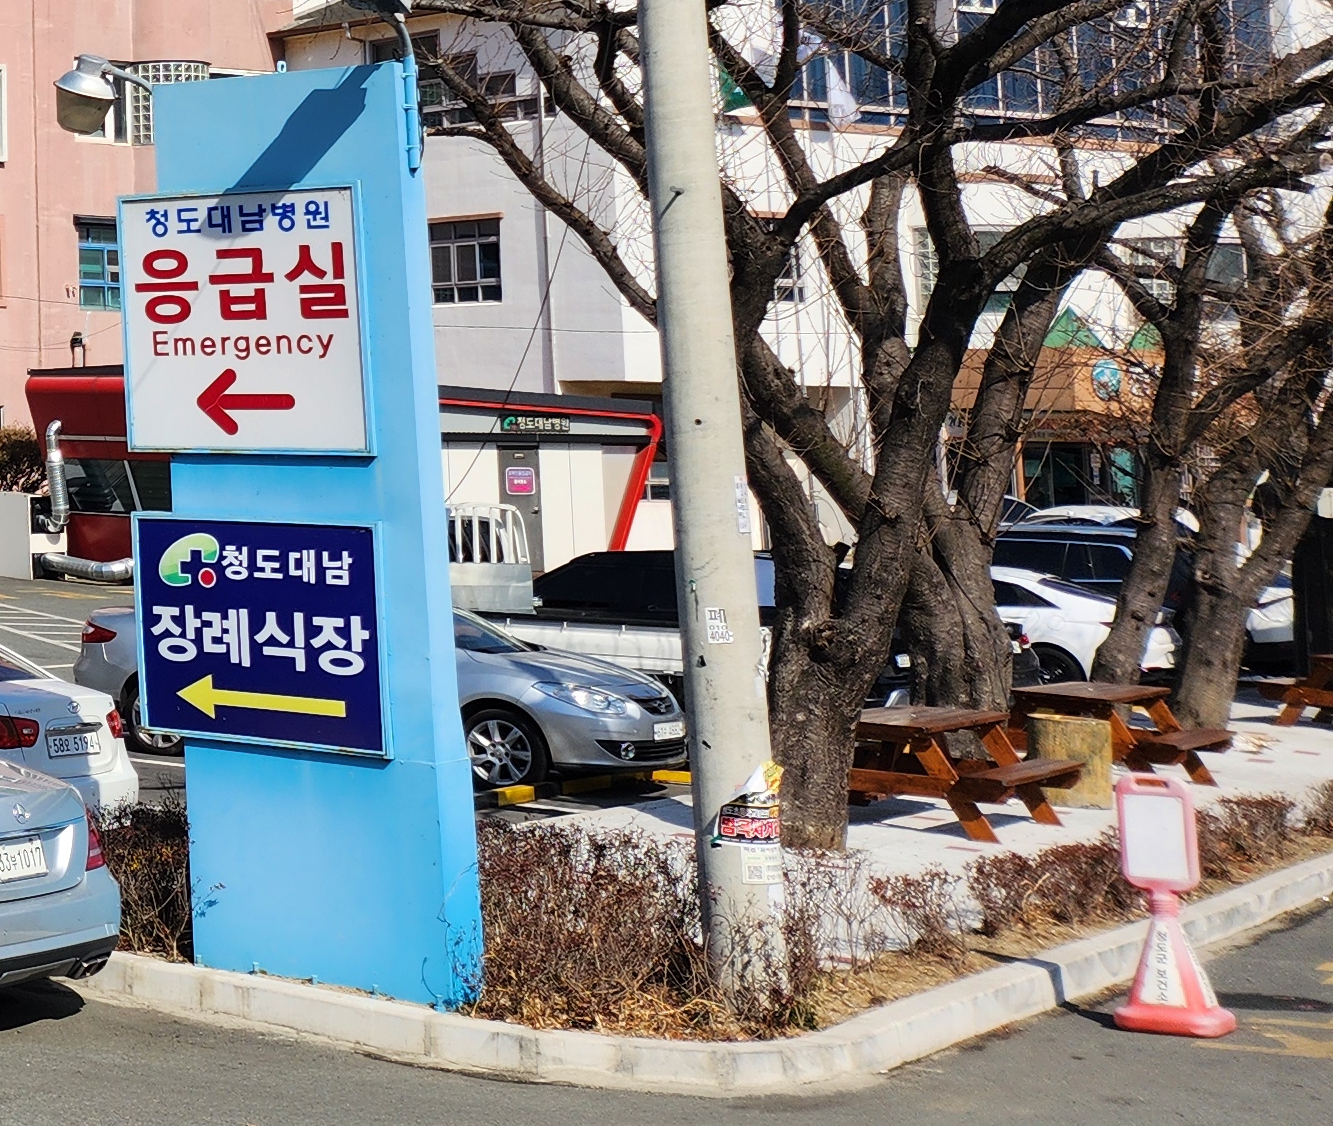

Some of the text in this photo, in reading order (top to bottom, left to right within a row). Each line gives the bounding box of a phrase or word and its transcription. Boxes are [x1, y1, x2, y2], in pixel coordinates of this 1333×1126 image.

[144, 199, 331, 238] 청도대남병원
[134, 241, 349, 324] 응급실
[152, 330, 334, 360] Emergency
[517, 416, 570, 430] 청도대남병원
[221, 543, 352, 587] 청도대남
[150, 604, 370, 678] 장례식장
